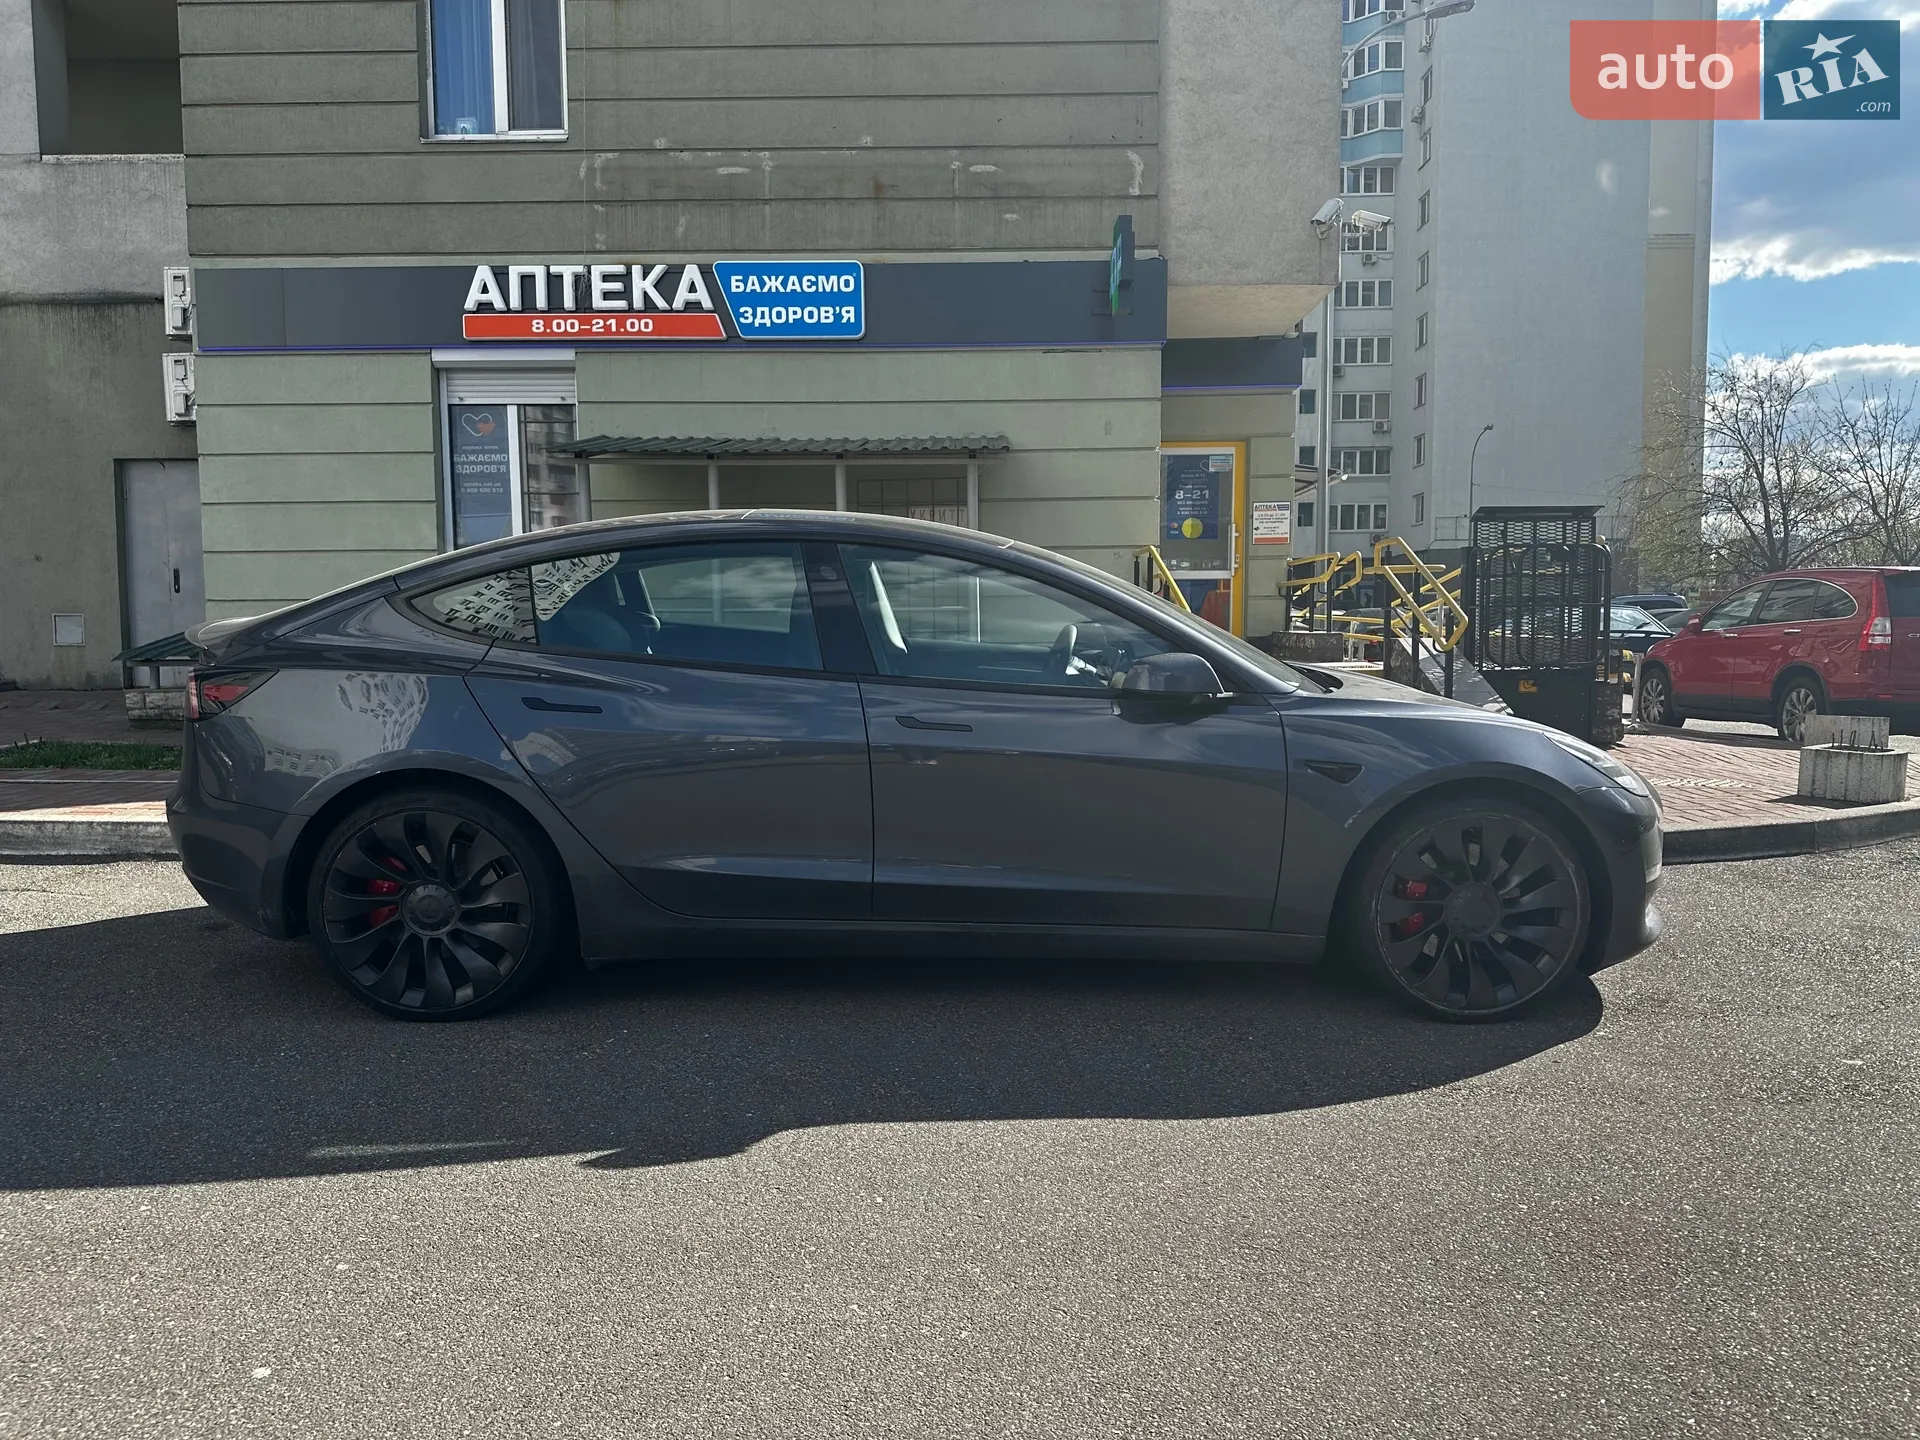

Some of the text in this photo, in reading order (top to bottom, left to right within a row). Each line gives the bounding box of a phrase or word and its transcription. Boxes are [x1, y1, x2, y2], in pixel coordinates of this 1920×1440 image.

[464, 264, 715, 311] АПТЕКА
[730, 275, 855, 293] БАЖАЄМО
[739, 306, 856, 327] ЗДОРОВ’Я
[531, 318, 654, 333] 8.00–21.00
[453, 453, 508, 462] БАЖАЄМО
[456, 465, 507, 475] ЗДОРОВ'Я
[1174, 489, 1210, 500] 8–21
[910, 508, 966, 522] УКРИТТ
